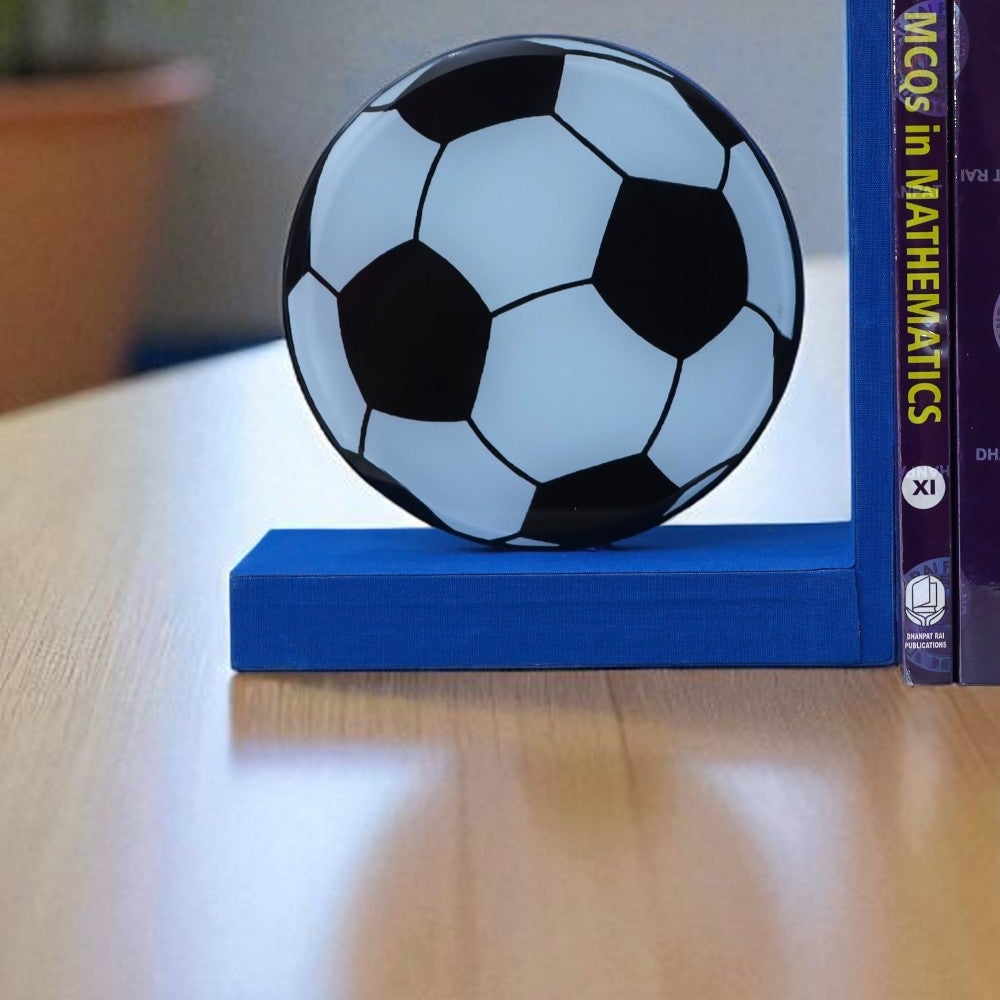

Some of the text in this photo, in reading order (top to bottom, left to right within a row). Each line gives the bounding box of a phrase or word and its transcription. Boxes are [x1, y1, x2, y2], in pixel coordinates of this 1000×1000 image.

[898, 12, 939, 113] MCQs
[905, 124, 940, 156] in
[905, 169, 942, 425] MATHEMATICS
[912, 479, 936, 496] XI
[904, 641, 947, 649] PUBLICATIONS
[906, 632, 945, 640] DHANPAT RAI
